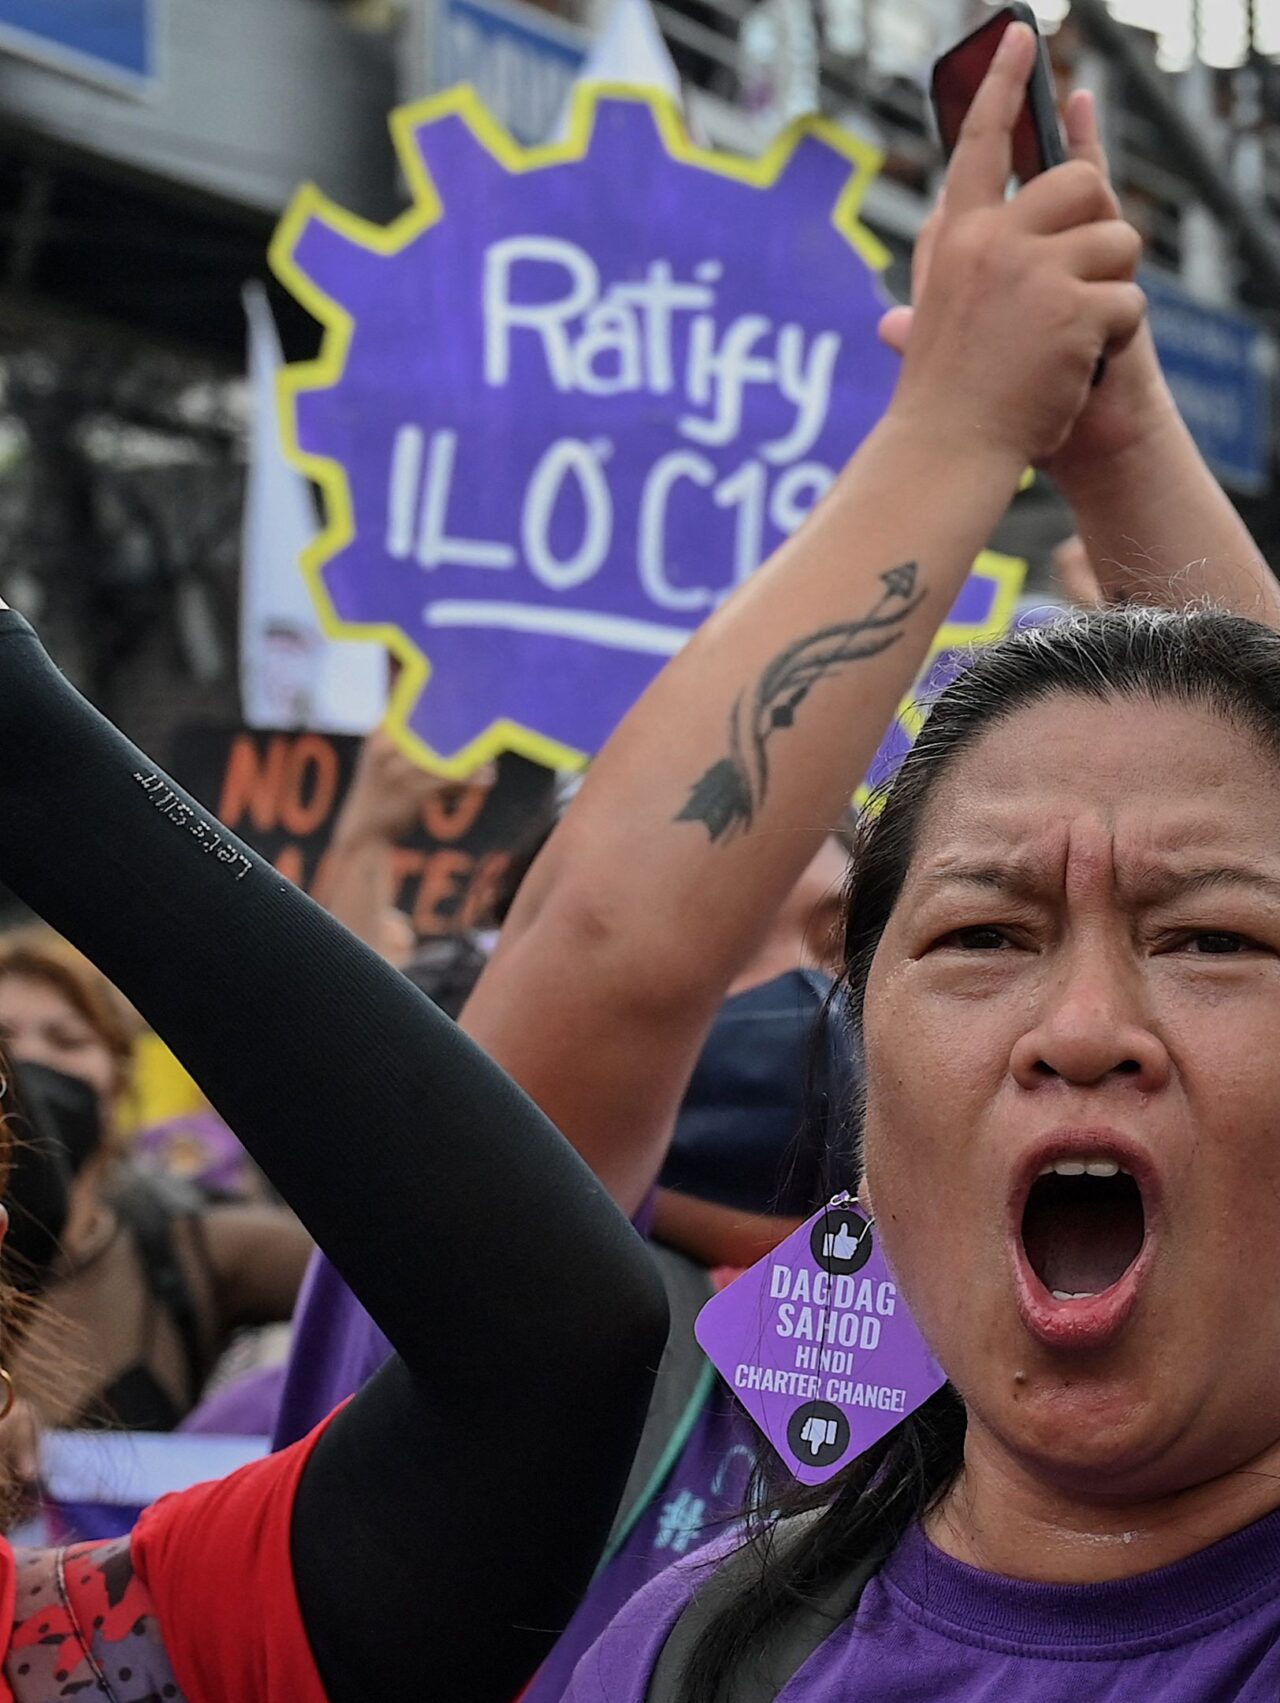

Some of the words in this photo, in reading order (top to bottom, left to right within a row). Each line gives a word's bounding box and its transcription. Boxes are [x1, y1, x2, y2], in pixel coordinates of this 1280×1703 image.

[483, 234, 842, 465] Ratify
[386, 422, 615, 590] ILO
[638, 449, 838, 612] C19
[770, 1264, 897, 1316] DAGDAG
[776, 1303, 882, 1351] SAHOD
[795, 1345, 854, 1375] HINDI
[735, 1364, 822, 1400] CHARTER
[826, 1378, 907, 1413] CHANGE!
